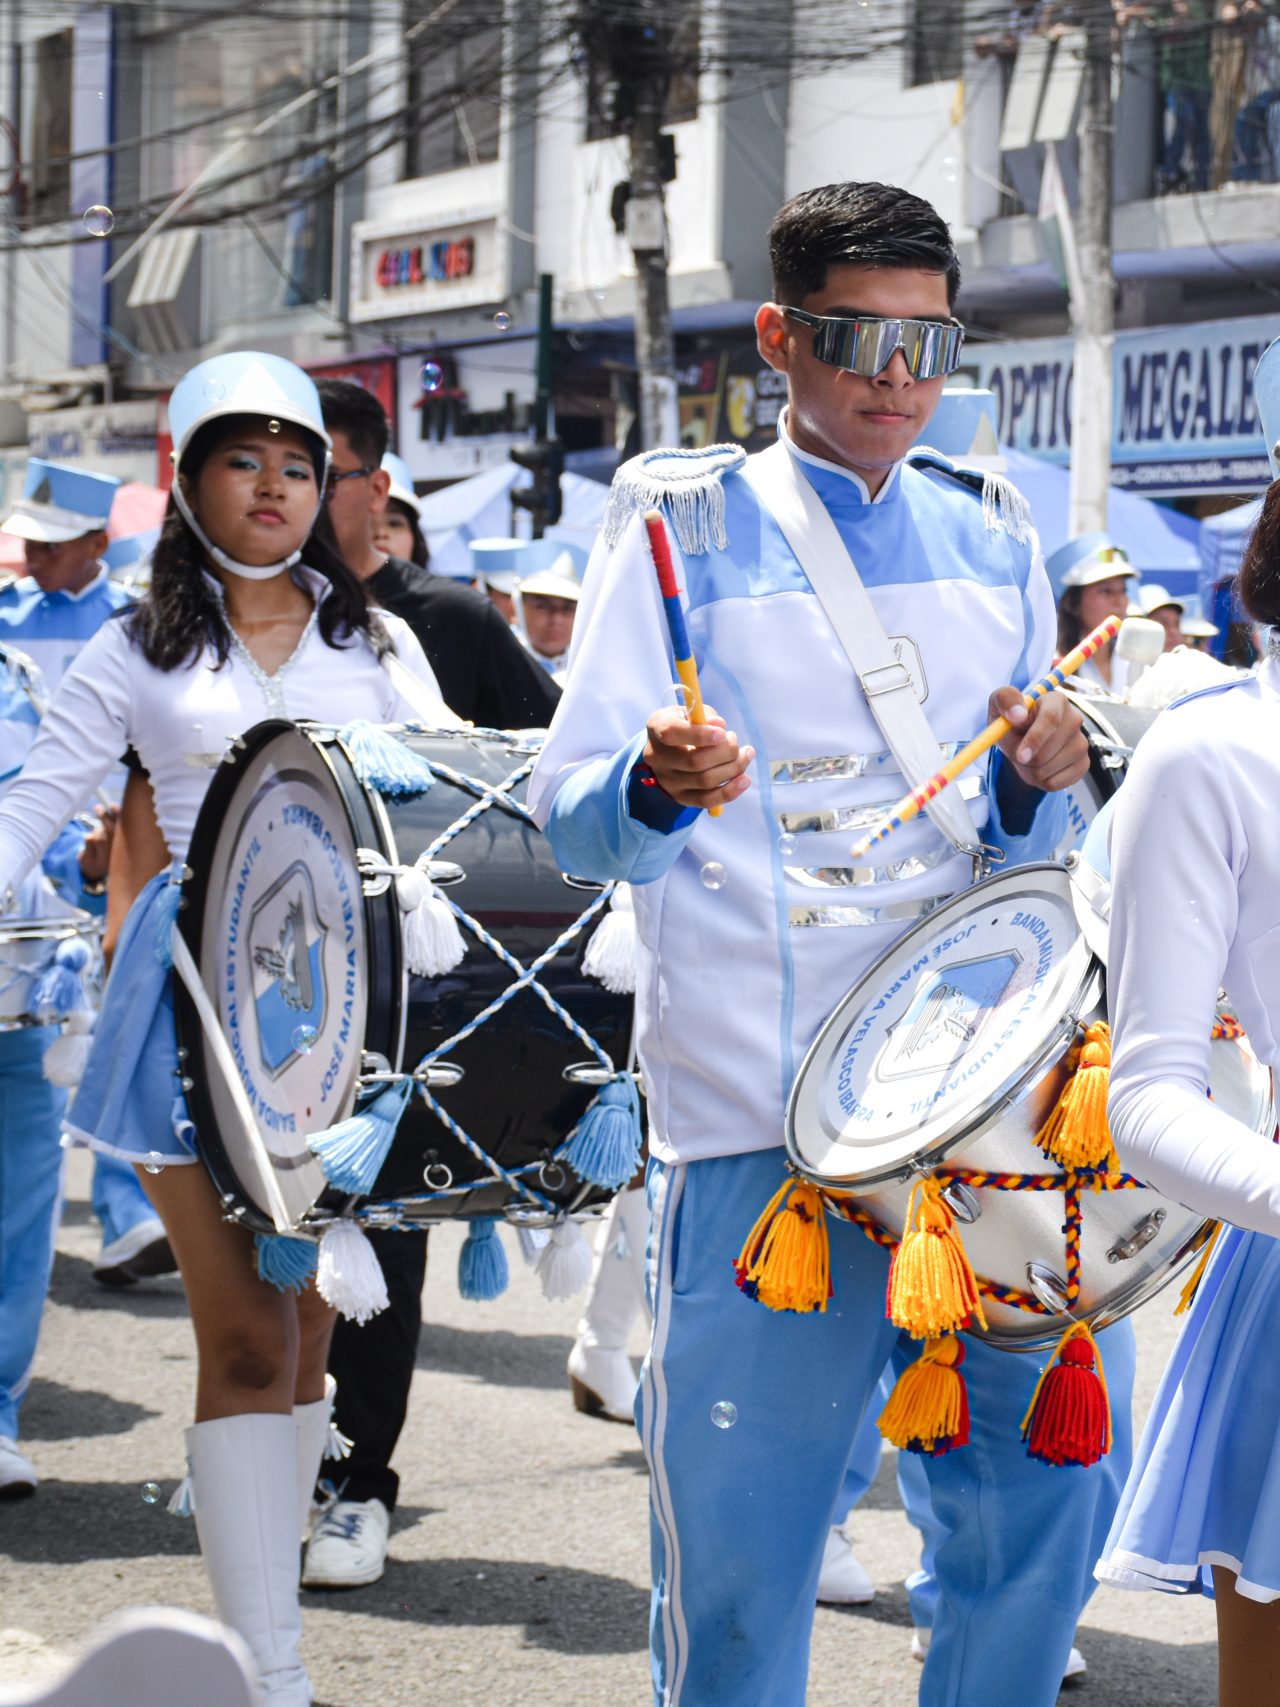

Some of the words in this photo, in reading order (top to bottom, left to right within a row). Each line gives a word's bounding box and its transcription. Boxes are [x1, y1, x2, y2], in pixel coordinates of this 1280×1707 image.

[1119, 338, 1274, 443] MEGALE
[225, 836, 263, 994] ESTUDIANTIL
[1009, 911, 1051, 944] BANDA
[1017, 937, 1054, 1016] MUSICAL
[320, 1041, 344, 1103] JOSÉ
[338, 948, 356, 1044] MARIA
[837, 1015, 877, 1092] VELASCO
[910, 1017, 1024, 1116] ESTUDIANTIL
[838, 1088, 875, 1122] IBARRA
